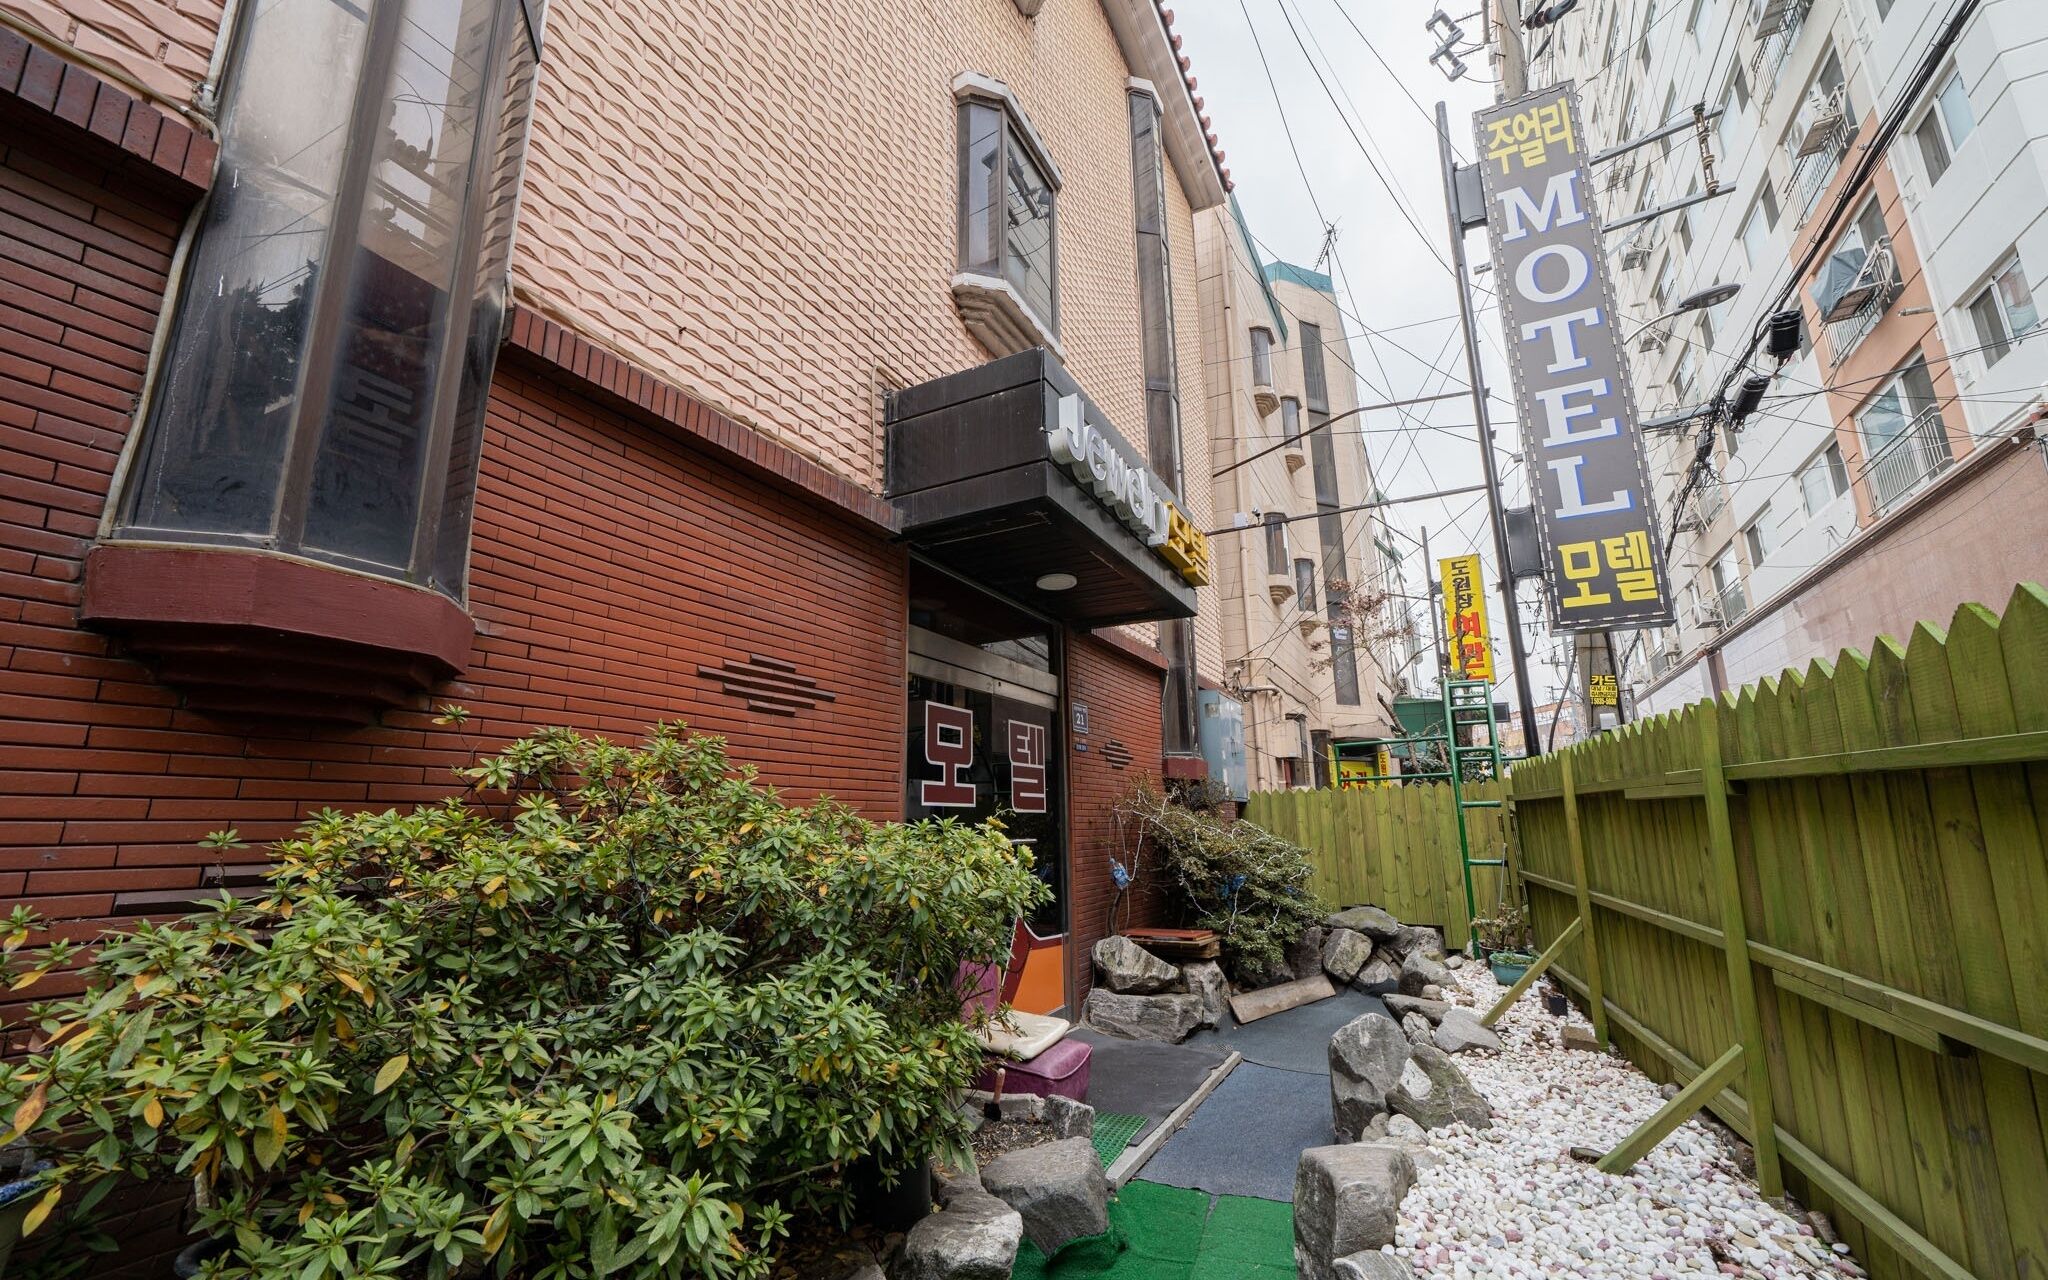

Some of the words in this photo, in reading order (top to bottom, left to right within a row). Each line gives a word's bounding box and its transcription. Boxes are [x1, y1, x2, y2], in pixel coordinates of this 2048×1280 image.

[1487, 97, 1577, 175] 주얼리
[1496, 170, 1633, 519] MOTEL
[1157, 501, 1209, 586] 모텔
[1558, 530, 1658, 608] 모텔
[1075, 713, 1085, 725] 21
[1591, 675, 1617, 686] 카드
[921, 700, 1047, 814] 모텔
